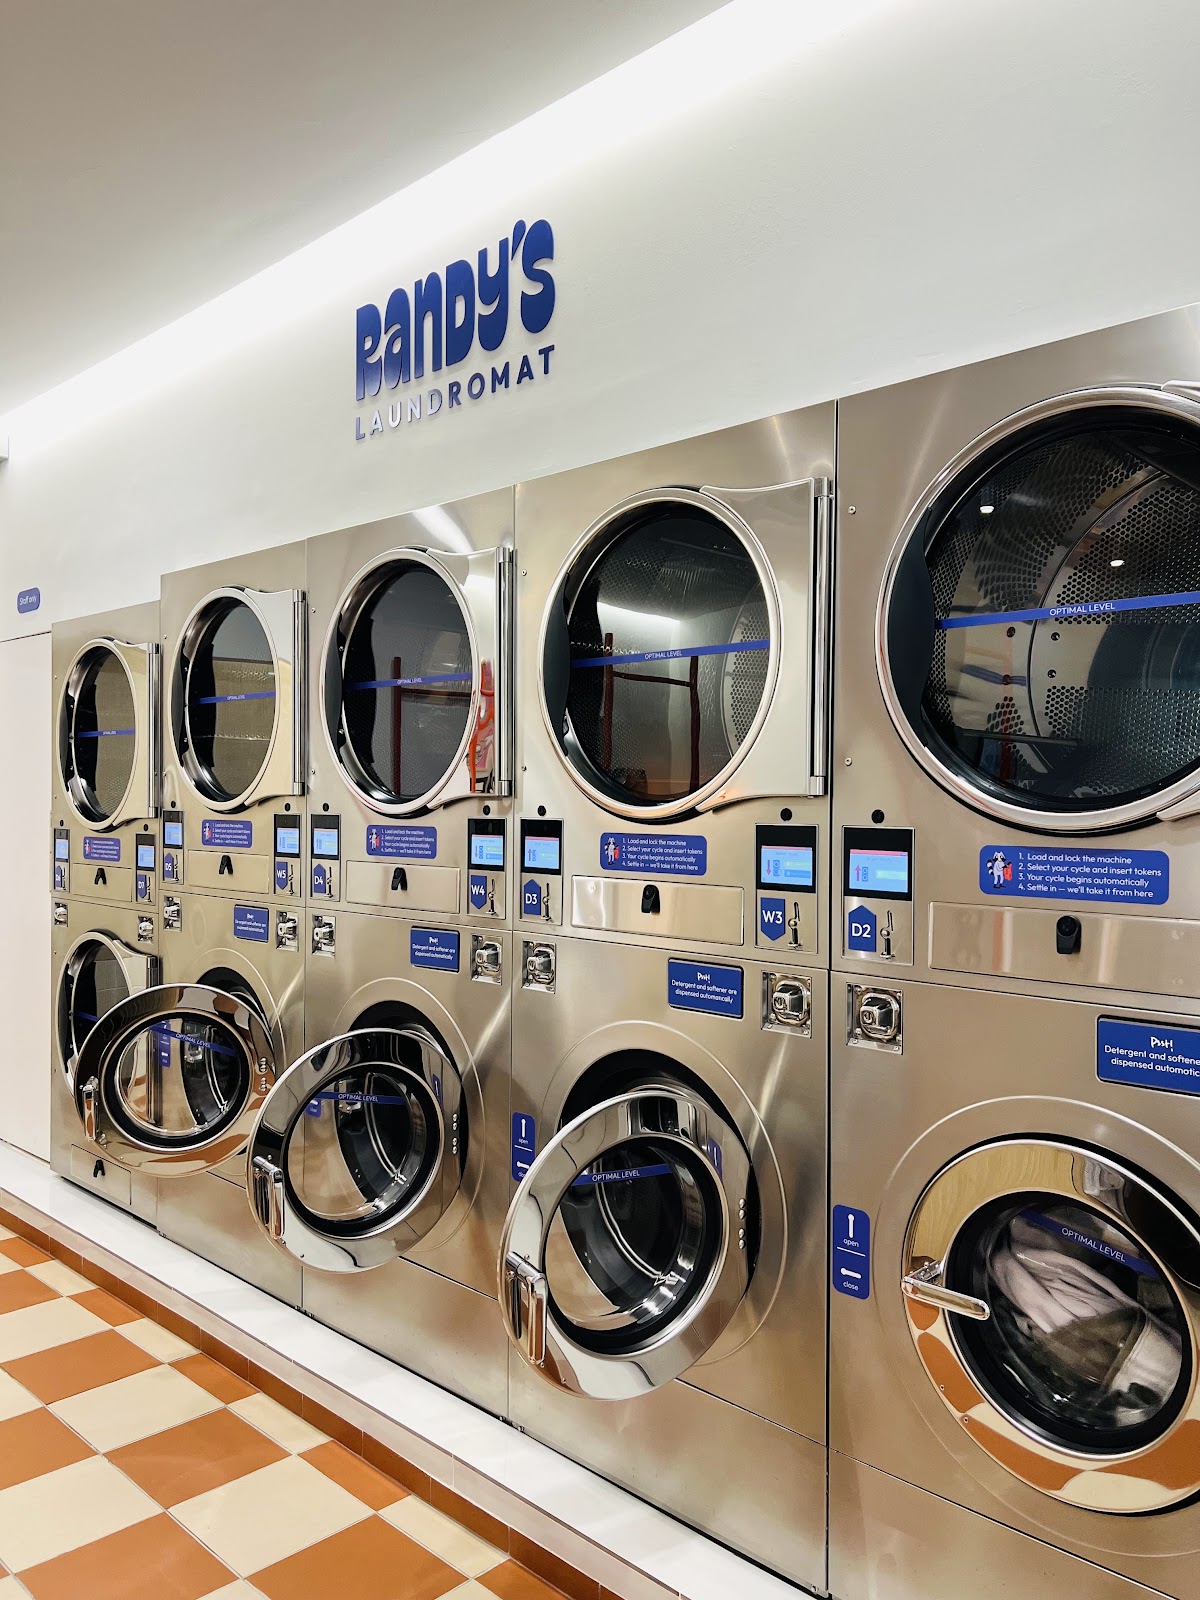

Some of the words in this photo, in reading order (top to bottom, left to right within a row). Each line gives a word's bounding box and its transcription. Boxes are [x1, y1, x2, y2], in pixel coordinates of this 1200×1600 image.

[356, 345, 555, 440] LAUNDROMAT
[1050, 606, 1087, 616] OPTIMAL
[1089, 602, 1115, 611] LEVEL
[644, 652, 666, 660] OPTIMAL
[665, 855, 696, 863] automatically
[1027, 853, 1047, 861] Load
[1048, 854, 1063, 862] and
[1065, 854, 1081, 862] lock
[1082, 855, 1096, 863] the
[1097, 856, 1132, 864] machine
[166, 863, 172, 871] D5
[1071, 865, 1090, 874] cycle
[1092, 866, 1108, 874] and
[1110, 867, 1132, 875] insert
[1134, 868, 1162, 876] tokens
[277, 870, 286, 878] W5
[315, 876, 323, 885] D4
[1027, 873, 1043, 881] Your
[1045, 875, 1065, 883] cycle
[1066, 875, 1092, 885] begins
[1094, 877, 1149, 888] automatically
[471, 885, 485, 895] W4
[1027, 884, 1048, 892] Settle
[1067, 886, 1085, 894] we'll
[1086, 887, 1103, 895] take
[1105, 887, 1111, 895] it
[1112, 888, 1132, 896] from
[1134, 889, 1154, 897] here
[526, 893, 537, 904] D3
[762, 910, 782, 924] W3
[852, 923, 871, 938] D2
[672, 980, 696, 989] Detergent
[707, 985, 727, 994] softener
[675, 989, 699, 998] dispensed
[700, 993, 733, 1004] automatically
[1105, 1045, 1146, 1057] Detergent
[1111, 1058, 1153, 1070] dispensed
[592, 1172, 620, 1181] OPTIMAL
[622, 1170, 640, 1178] LEVEL
[843, 1238, 859, 1247] open
[1061, 1227, 1098, 1250] OPTIMAL
[1100, 1244, 1126, 1262] LEVEL
[843, 1281, 858, 1291] close
